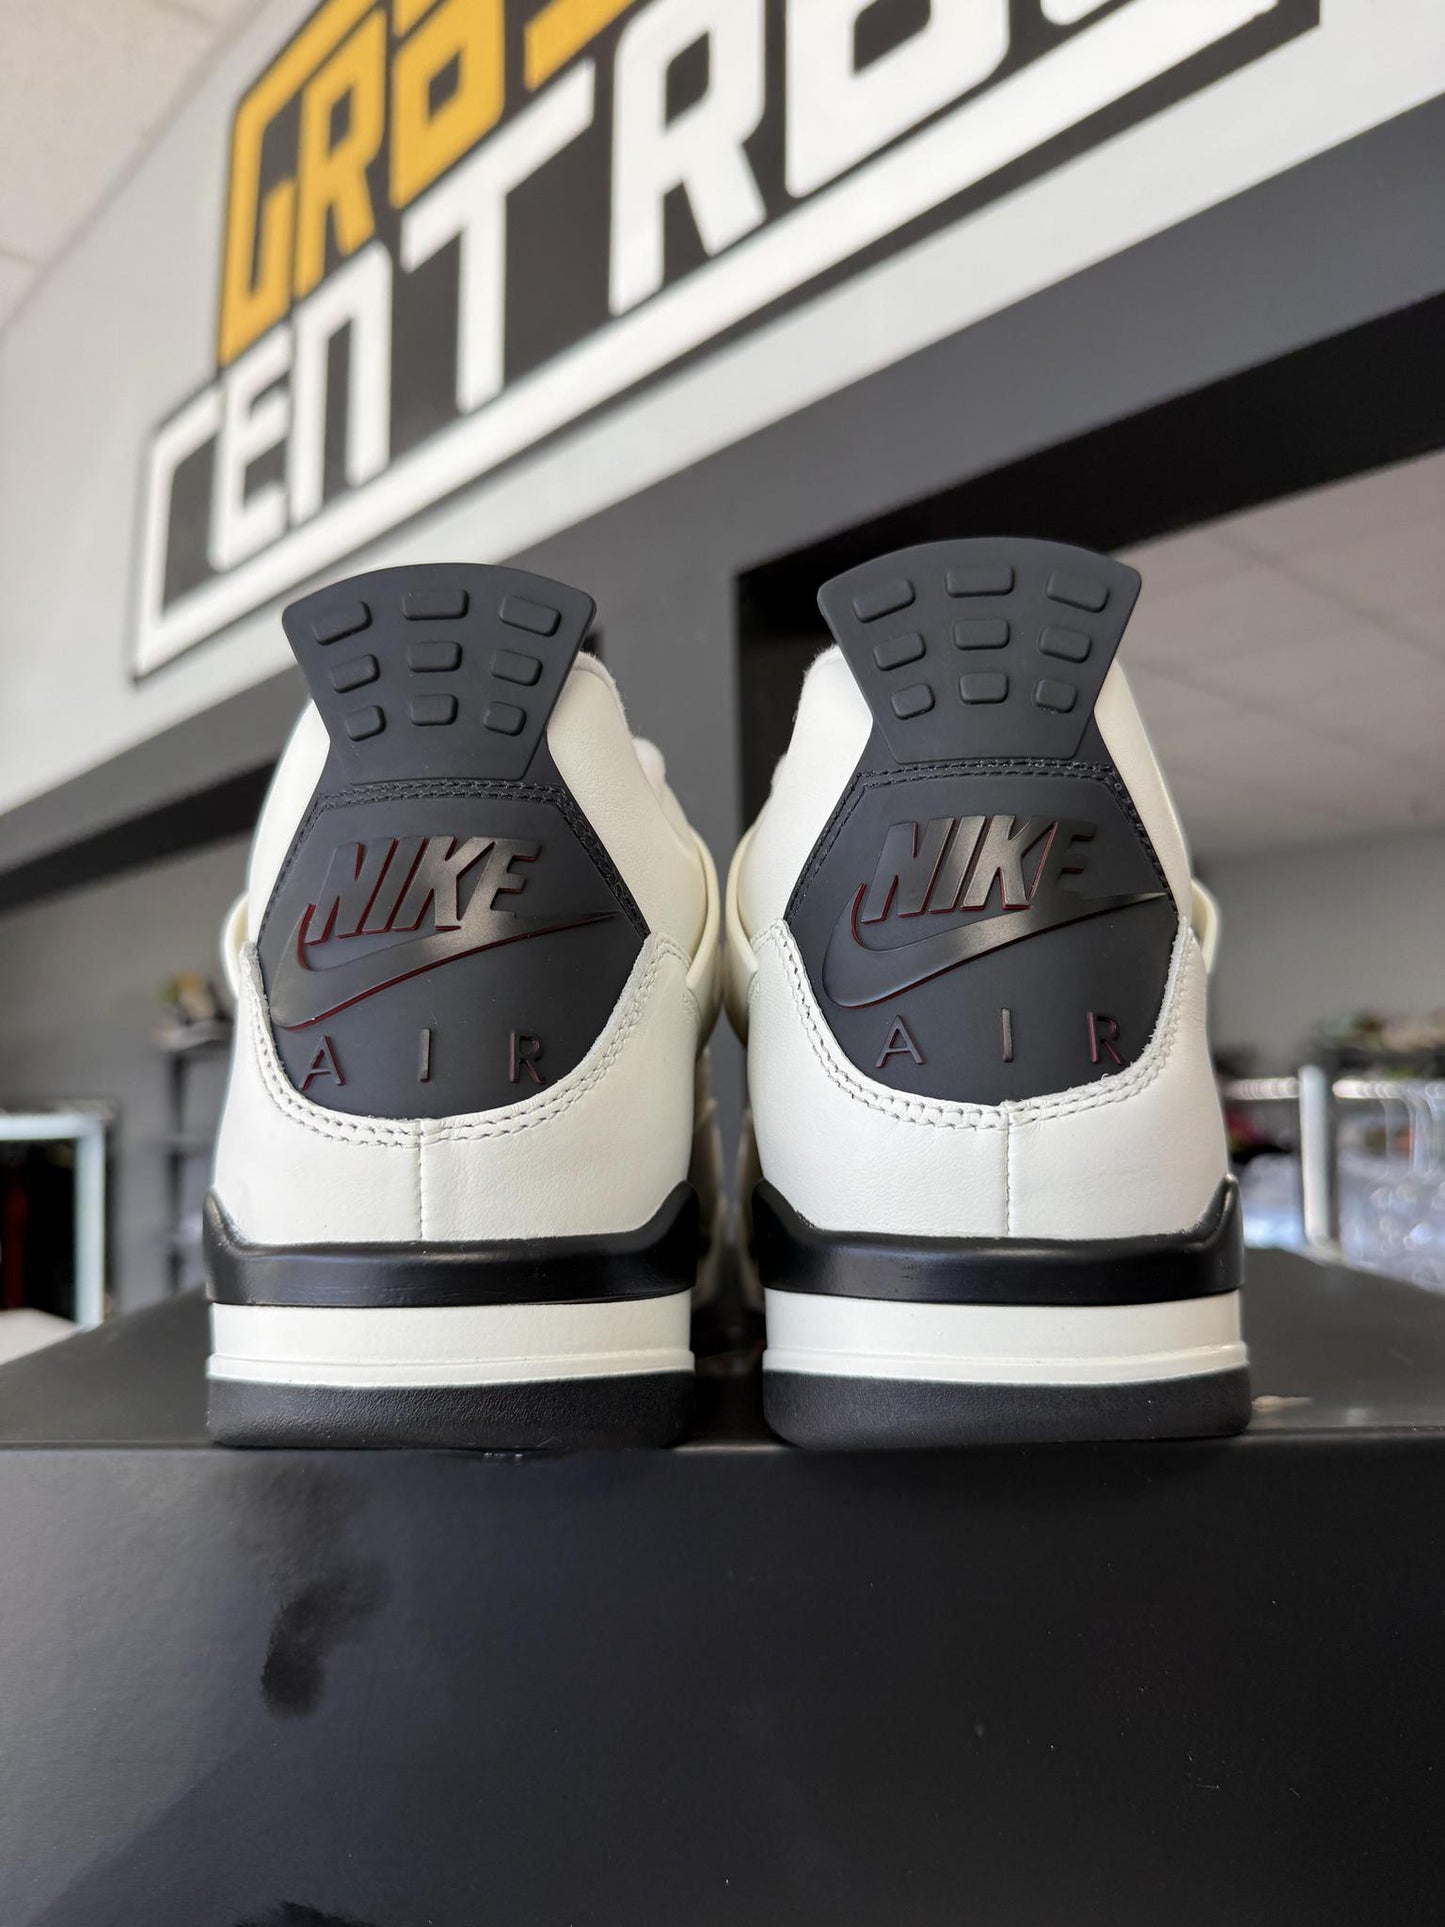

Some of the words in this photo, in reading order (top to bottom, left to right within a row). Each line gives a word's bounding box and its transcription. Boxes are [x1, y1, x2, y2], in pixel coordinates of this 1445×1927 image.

[304, 835, 544, 947] NIKE
[861, 814, 1097, 924] NIKE
[301, 1026, 546, 1091] AIR
[875, 1006, 1125, 1069] AIR
